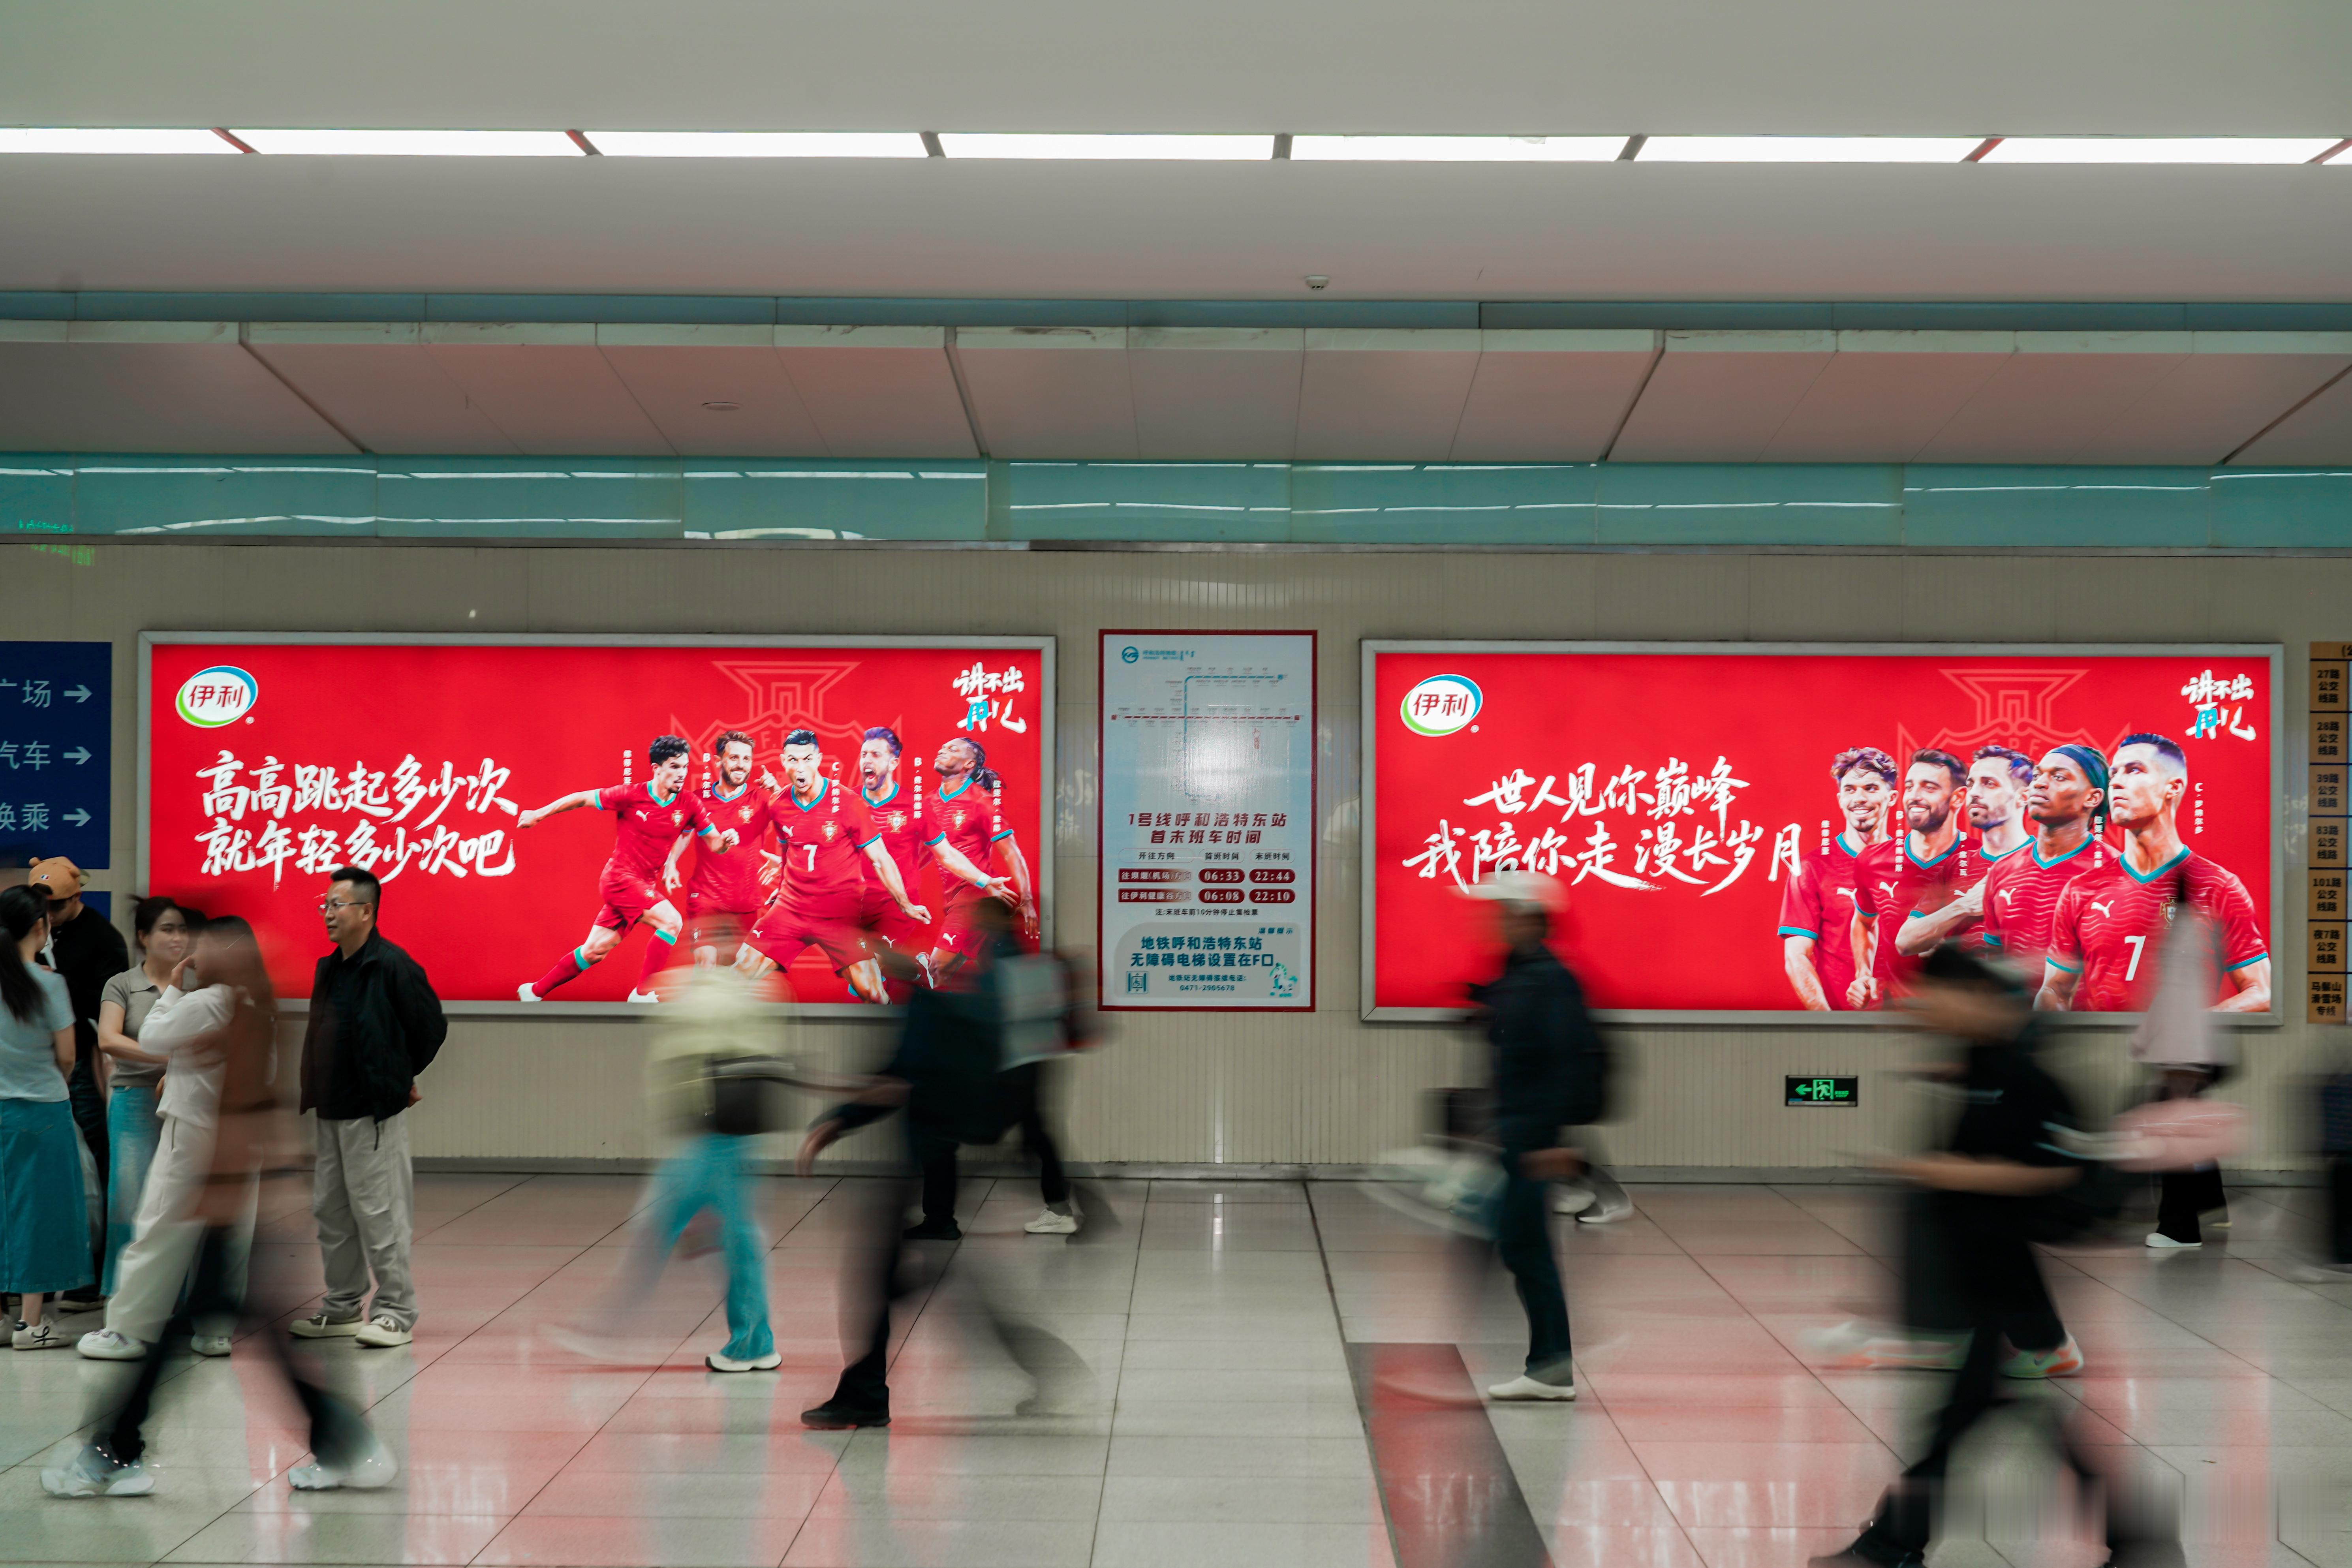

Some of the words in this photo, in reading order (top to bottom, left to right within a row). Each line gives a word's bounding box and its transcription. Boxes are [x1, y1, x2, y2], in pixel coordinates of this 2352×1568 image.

[952, 662, 1025, 697] 讲不出
[2317, 669, 2340, 679] 27路
[2181, 669, 2254, 703] 讲不出
[2319, 682, 2339, 691] 公交
[188, 684, 244, 708] 伊利
[1413, 693, 1469, 717] 伊利
[2318, 734, 2339, 743] 公交
[195, 750, 518, 831] 高高跳起多少次
[2318, 786, 2338, 795] 公交
[1463, 756, 1751, 843] 世人见你巅峰
[1128, 812, 1288, 827] 1号线呼和浩特东站
[1150, 830, 1262, 844] 首末班车时间
[2318, 838, 2337, 847] 公交
[195, 817, 516, 891] 就年轻多少次吧
[803, 844, 818, 872] 7
[1138, 852, 1175, 860] 开往方向
[1205, 852, 1240, 860] 首班时间
[1255, 852, 1291, 861] 末班时间
[1204, 871, 1240, 881] 06:33
[1254, 871, 1291, 881] 22:44
[1204, 891, 1239, 901] 06:08
[1254, 891, 1290, 901] 22:10
[2317, 890, 2337, 900] 公交
[1141, 936, 1263, 951] 地铁呼和浩特东站
[2317, 942, 2337, 952] 公交
[1130, 953, 1274, 967] 无障碍电梯设置在F口
[2124, 936, 2146, 982] 7
